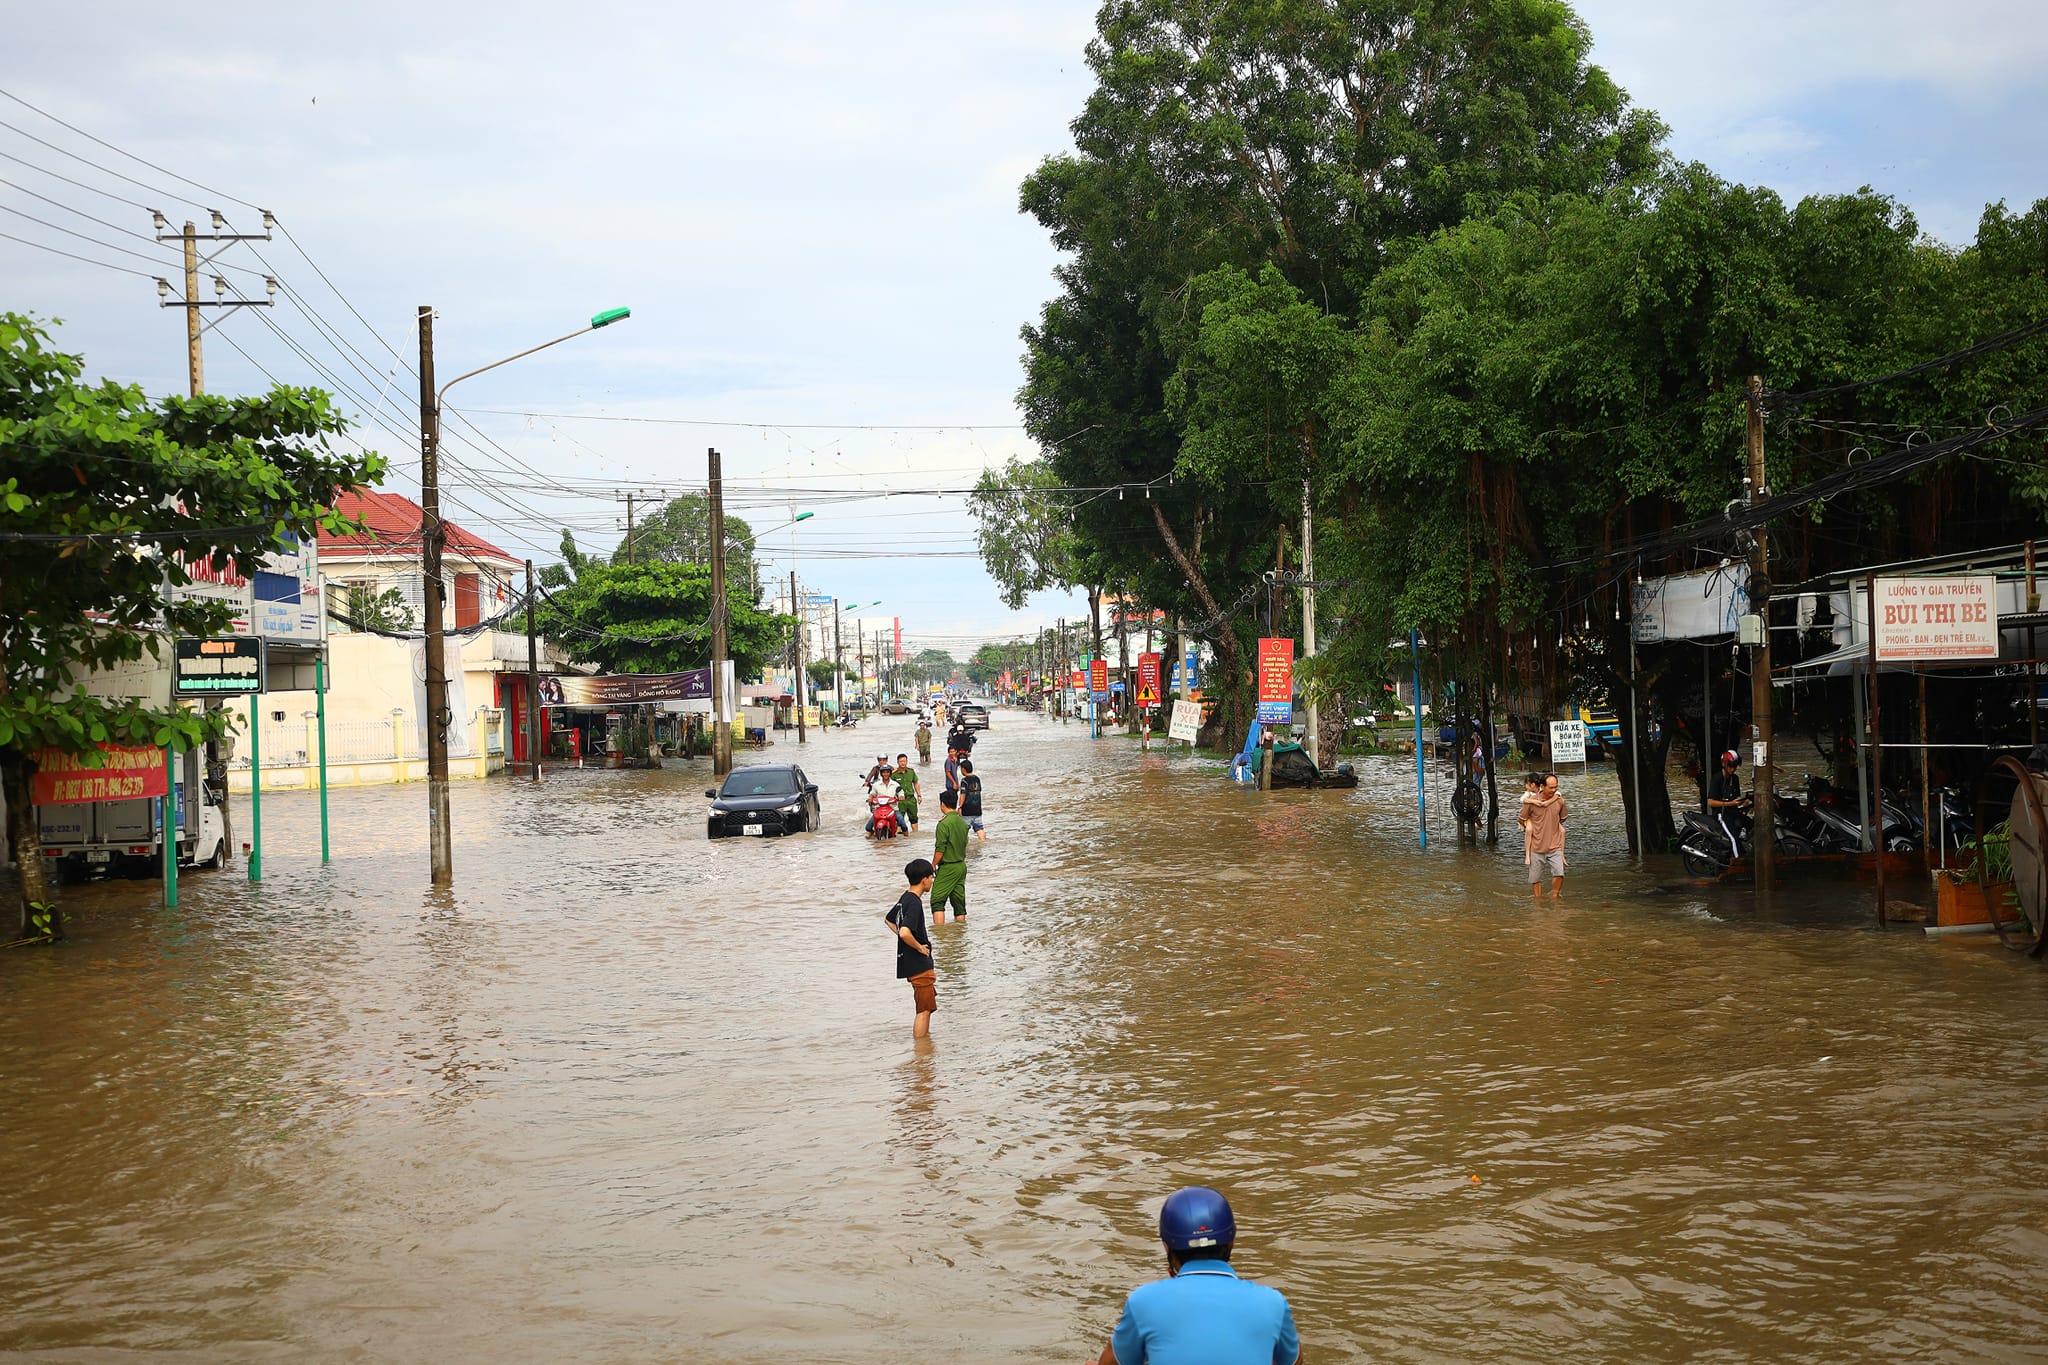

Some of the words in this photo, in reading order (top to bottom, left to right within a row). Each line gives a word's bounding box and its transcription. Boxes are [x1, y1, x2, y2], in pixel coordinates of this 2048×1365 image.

[1920, 586, 1926, 596] Y
[1928, 585, 1944, 595] GIA
[1884, 600, 1918, 625] BÙI
[1922, 603, 1957, 628] THỊ
[1961, 597, 1987, 623] BÉ
[692, 682, 704, 690] PNJ
[1177, 703, 1199, 715] RỬA
[1181, 714, 1195, 724] XE
[1554, 722, 1569, 731] RỬA
